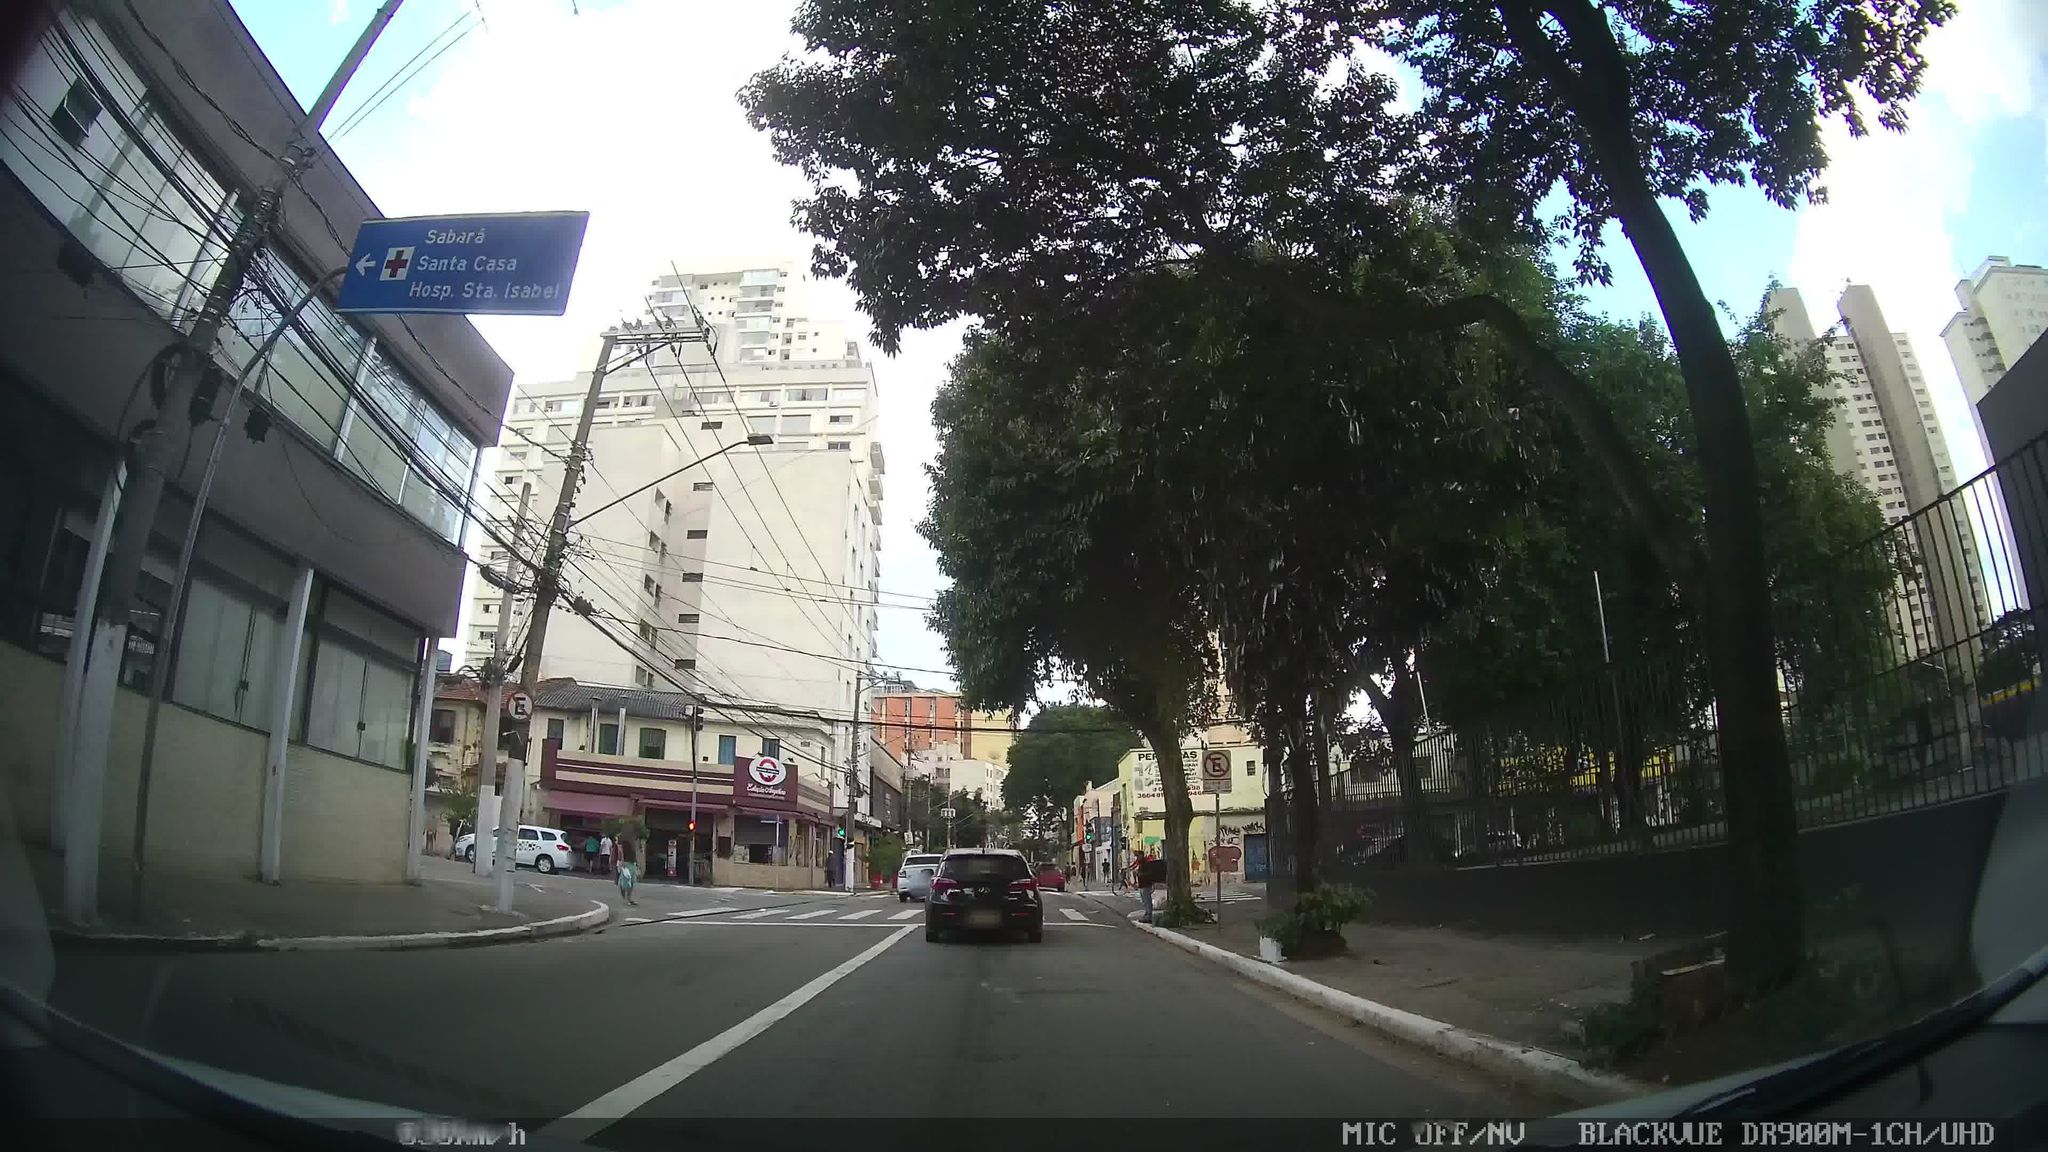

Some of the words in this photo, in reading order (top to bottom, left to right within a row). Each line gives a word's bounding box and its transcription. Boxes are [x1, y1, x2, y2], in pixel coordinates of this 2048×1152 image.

[425, 228, 485, 244] Sabará
[417, 255, 467, 271] Santa
[474, 256, 517, 271] Casa
[409, 281, 454, 300] Hosp.
[462, 282, 497, 298] Sta.
[504, 282, 559, 299] Isabel
